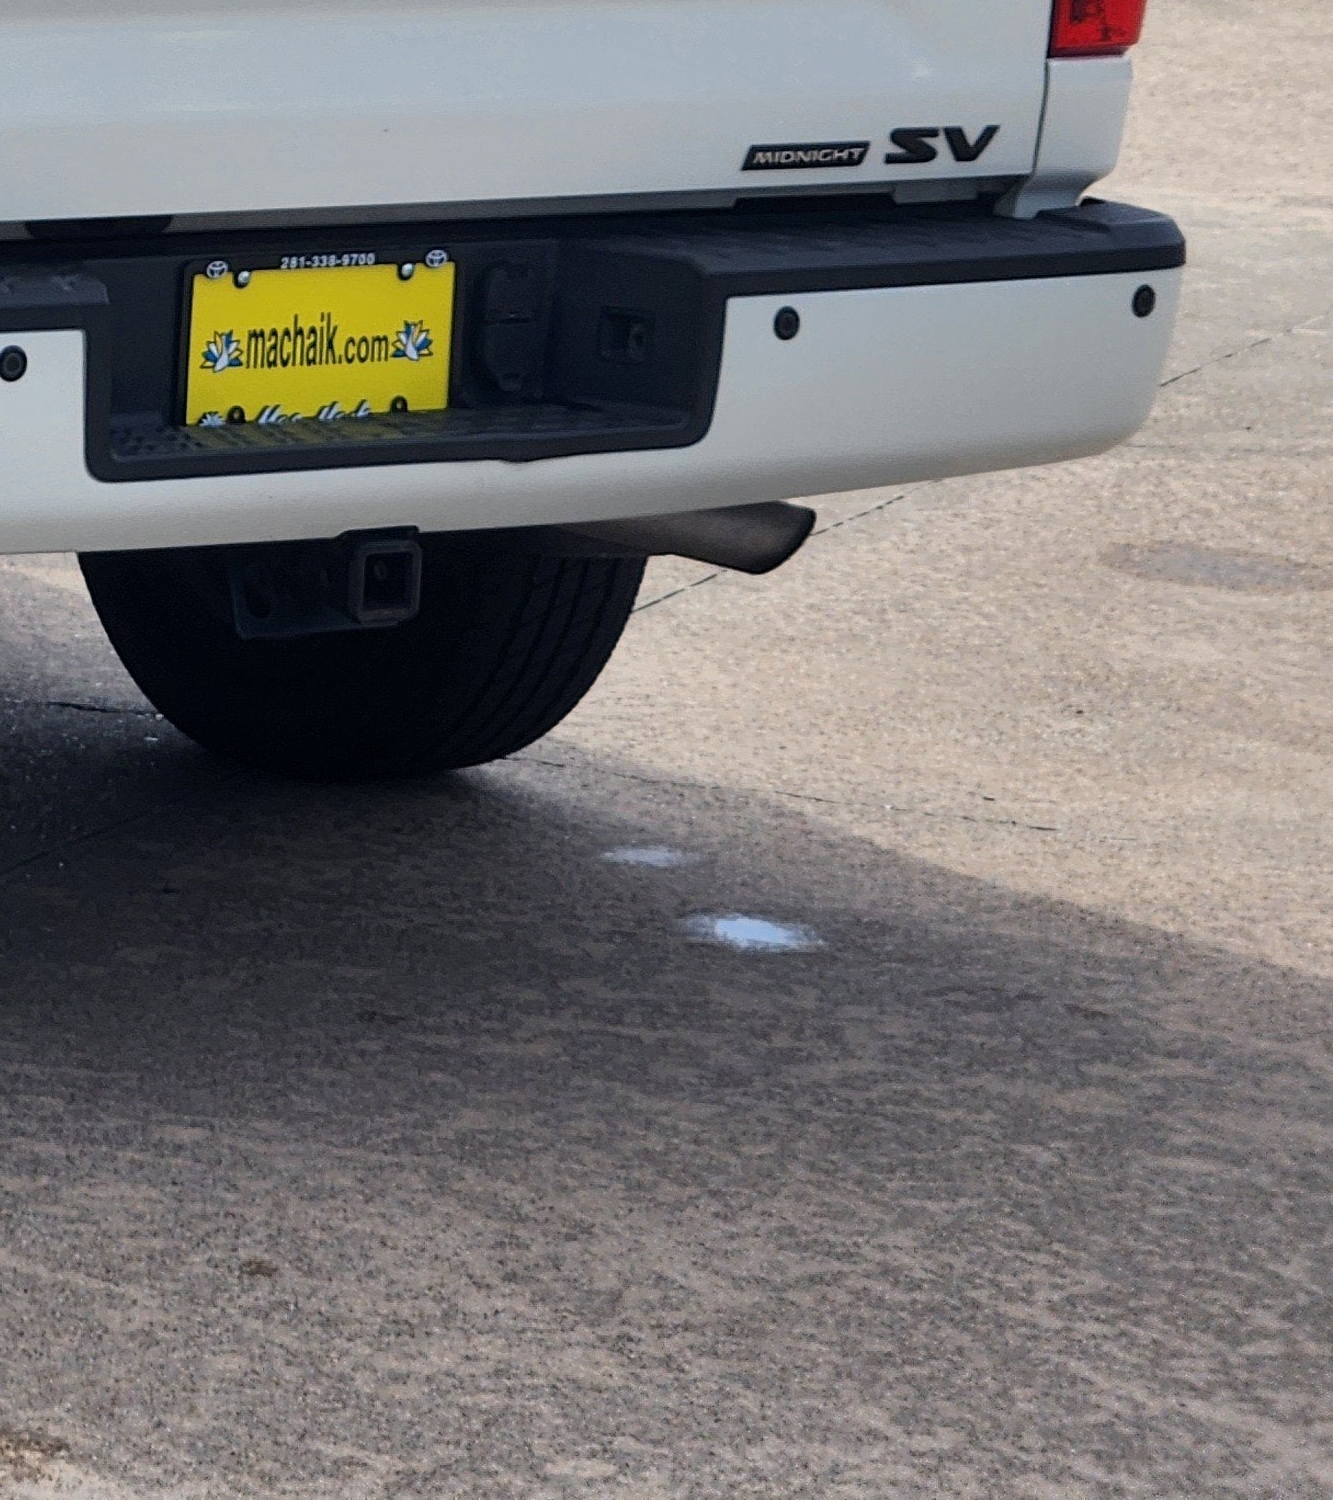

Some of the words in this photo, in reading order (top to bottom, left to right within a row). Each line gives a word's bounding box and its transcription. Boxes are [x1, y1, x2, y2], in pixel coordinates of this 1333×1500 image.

[753, 148, 864, 163] MIDNIGHT
[884, 125, 1000, 164] SV
[245, 311, 389, 369] machaik.com
